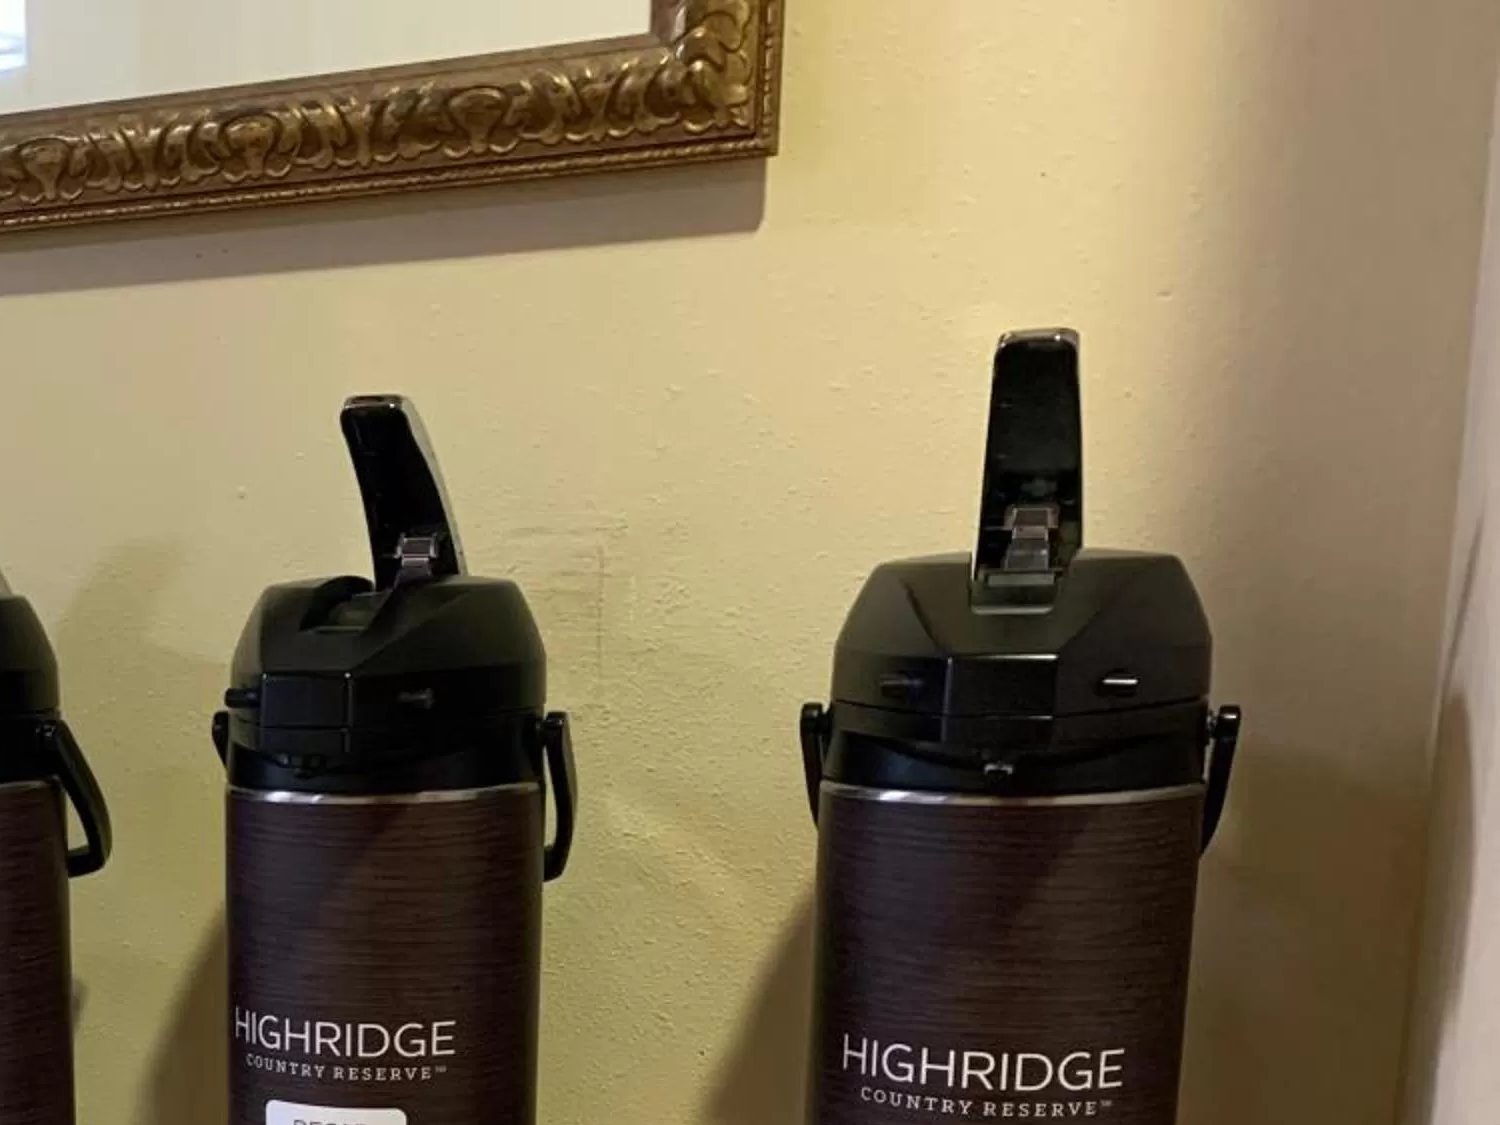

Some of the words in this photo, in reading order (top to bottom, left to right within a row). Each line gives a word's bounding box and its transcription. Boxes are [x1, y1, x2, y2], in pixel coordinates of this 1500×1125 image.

[235, 1005, 457, 1058] HIGHRIDGE
[246, 1053, 326, 1079] COUNTRY
[843, 1033, 1126, 1092] HIGHRIDGE
[861, 1086, 974, 1115] COUNTRY
